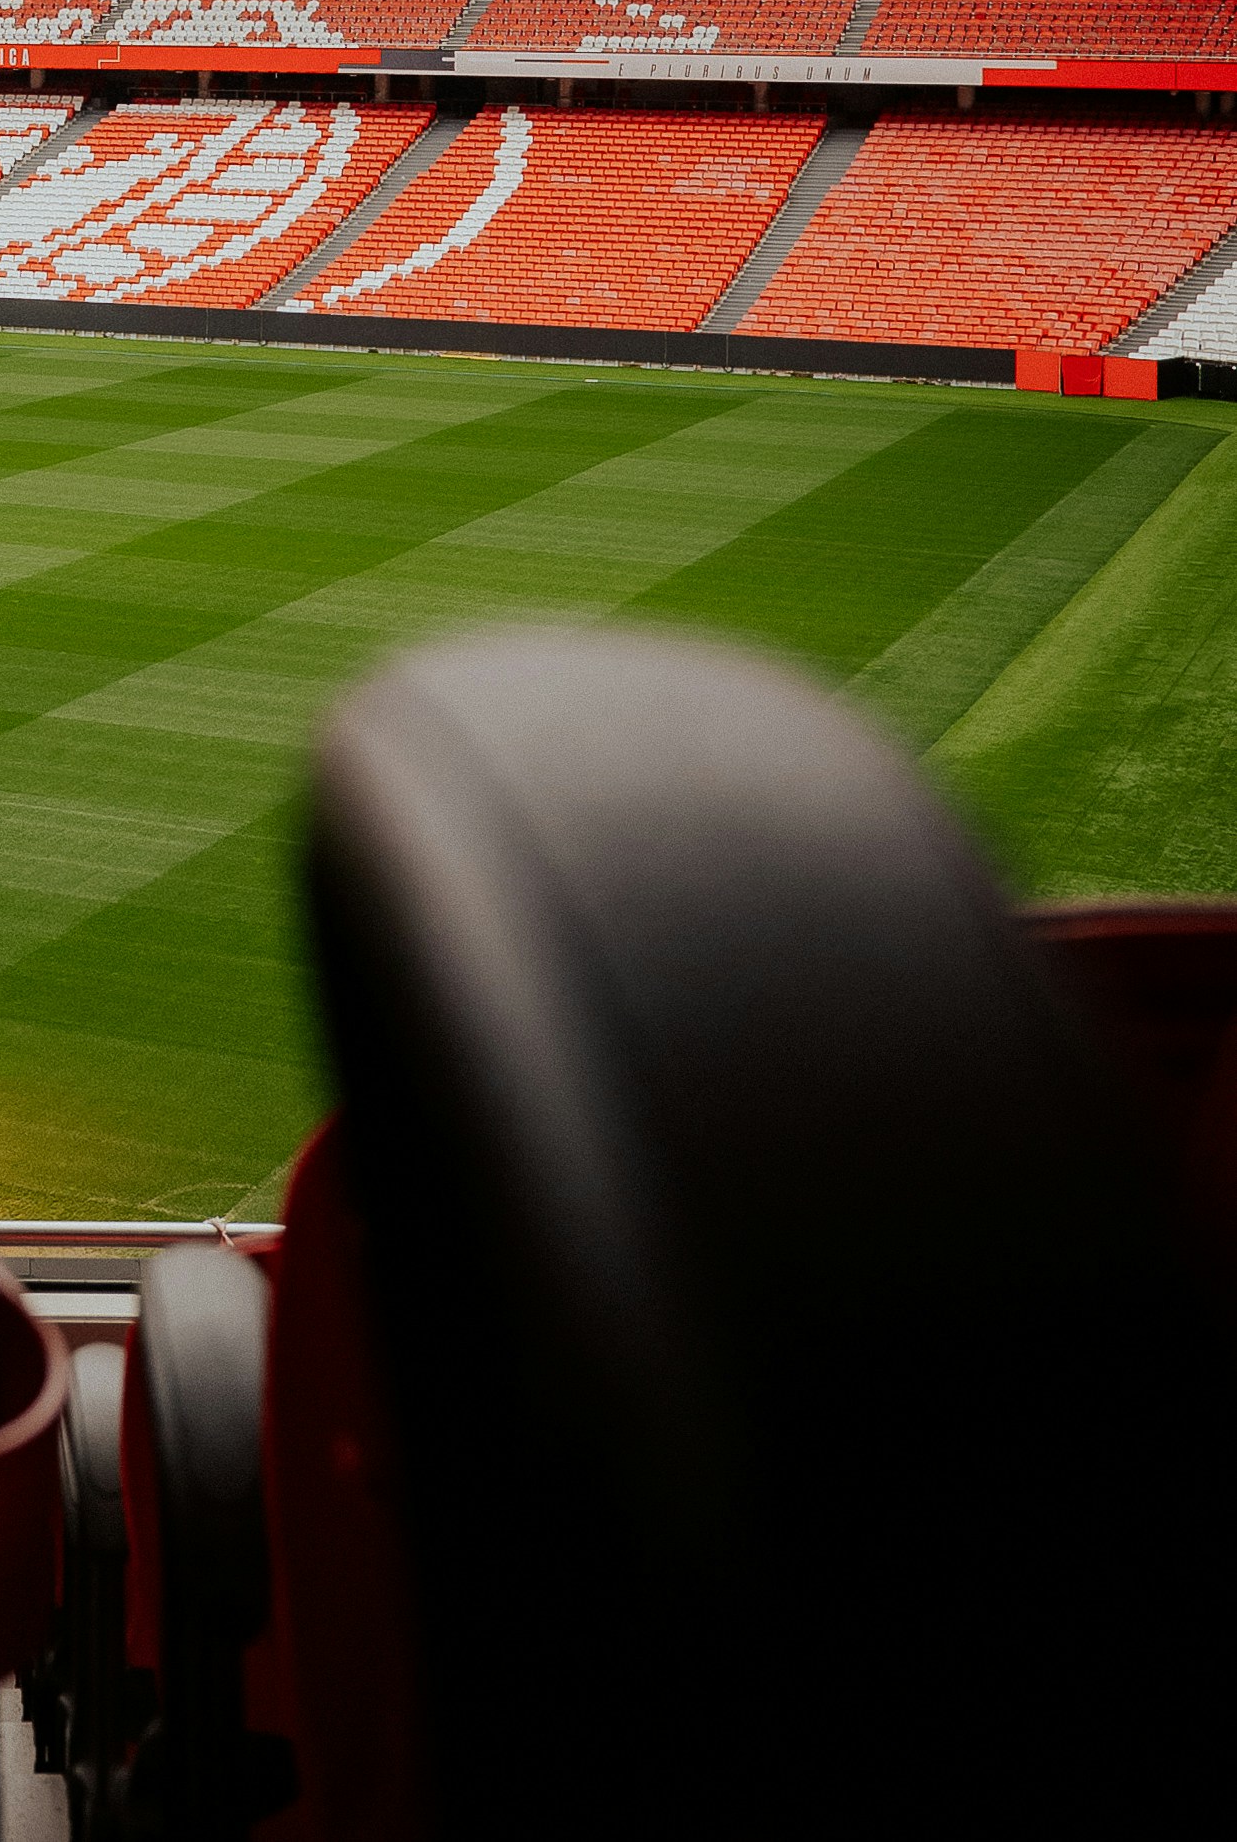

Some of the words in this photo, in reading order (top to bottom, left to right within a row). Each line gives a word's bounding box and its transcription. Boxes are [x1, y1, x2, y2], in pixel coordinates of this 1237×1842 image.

[618, 63, 625, 77] E
[650, 63, 780, 80] PLURIBUS
[805, 66, 871, 81] UNUM
